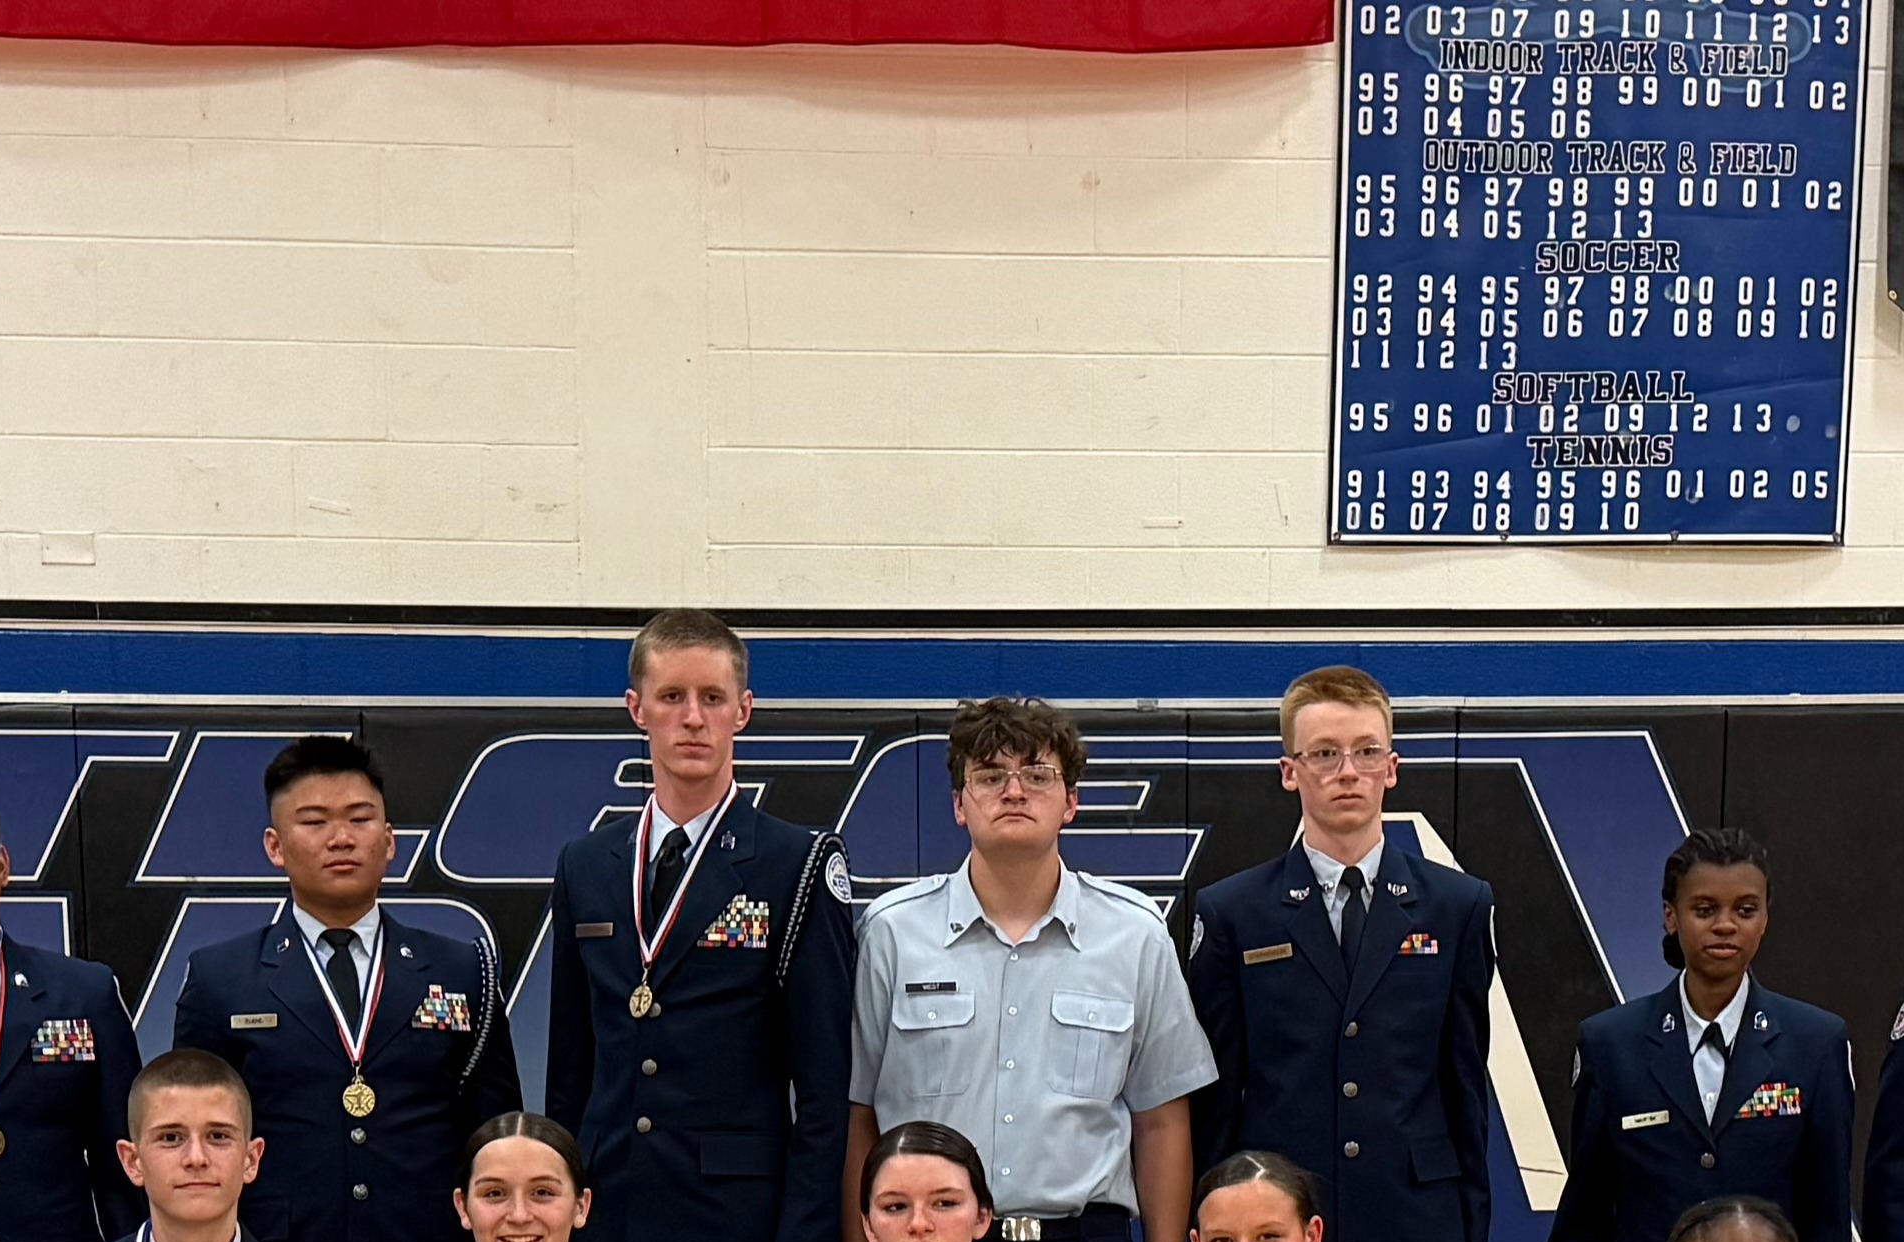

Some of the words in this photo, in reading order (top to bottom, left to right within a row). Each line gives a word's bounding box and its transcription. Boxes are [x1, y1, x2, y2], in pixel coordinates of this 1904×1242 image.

[1360, 5, 1401, 35] 02
[1426, 5, 1466, 36] 03
[1490, 7, 1529, 38] 07
[1554, 9, 1595, 39] 09
[1620, 8, 1661, 39] 10
[1685, 10, 1723, 41] 11
[1748, 12, 1788, 42] 12
[1812, 14, 1849, 45] 13
[1438, 38, 1544, 75] INDOOR
[1556, 40, 1658, 75] TRACK
[1668, 41, 1688, 75] &
[1700, 42, 1789, 77] FIELD
[1358, 72, 1399, 102] 95
[1424, 73, 1464, 103] 96
[1488, 75, 1527, 105] 97
[1552, 76, 1592, 106] 98
[1618, 75, 1658, 105] 99
[1682, 77, 1721, 107] 00
[1746, 78, 1784, 108] 01
[1809, 80, 1846, 111] 02
[1423, 138, 1554, 174] OUTDOOR
[1566, 140, 1667, 175] TRACK
[1678, 141, 1697, 175] &
[1709, 142, 1797, 176] FIELD
[1356, 174, 1396, 204] 95
[1421, 175, 1460, 205] 96
[1484, 177, 1523, 207] 97
[1548, 177, 1588, 207] 98
[1614, 177, 1654, 206] 99
[1678, 177, 1718, 207] 00
[1742, 178, 1780, 208] 01
[1805, 180, 1842, 210] 02
[1534, 240, 1680, 274] SOCCER
[1353, 274, 1393, 303] 92
[1418, 274, 1457, 304] 94
[1481, 276, 1519, 305] 95
[1544, 276, 1585, 305] 97
[1610, 275, 1650, 305] 98
[1674, 276, 1714, 305] 00
[1738, 276, 1776, 306] 01
[1801, 278, 1837, 307] 02
[1352, 307, 1391, 336] 03
[1417, 307, 1456, 337] 04
[1480, 308, 1518, 338] 05
[1543, 308, 1583, 338] 06
[1608, 308, 1649, 337] 07
[1673, 308, 1713, 337] 08
[1737, 308, 1775, 338] 09
[1799, 310, 1836, 339] 10
[1491, 370, 1695, 404] SOFTBALL
[1349, 403, 1389, 431] 95
[1414, 403, 1452, 432] 96
[1476, 404, 1513, 433] 01
[1539, 404, 1579, 433] 02
[1604, 403, 1644, 432] 09
[1669, 403, 1708, 432] 12
[1732, 403, 1771, 432] 13
[1526, 434, 1675, 468] TENNIS
[1347, 469, 1386, 498] 91
[1411, 470, 1449, 499] 93
[1474, 470, 1511, 499] 94
[1536, 470, 1576, 499] 95
[1601, 470, 1641, 499] 96
[1666, 469, 1704, 498] 01
[1729, 469, 1768, 498] 02
[1792, 470, 1828, 499] 05
